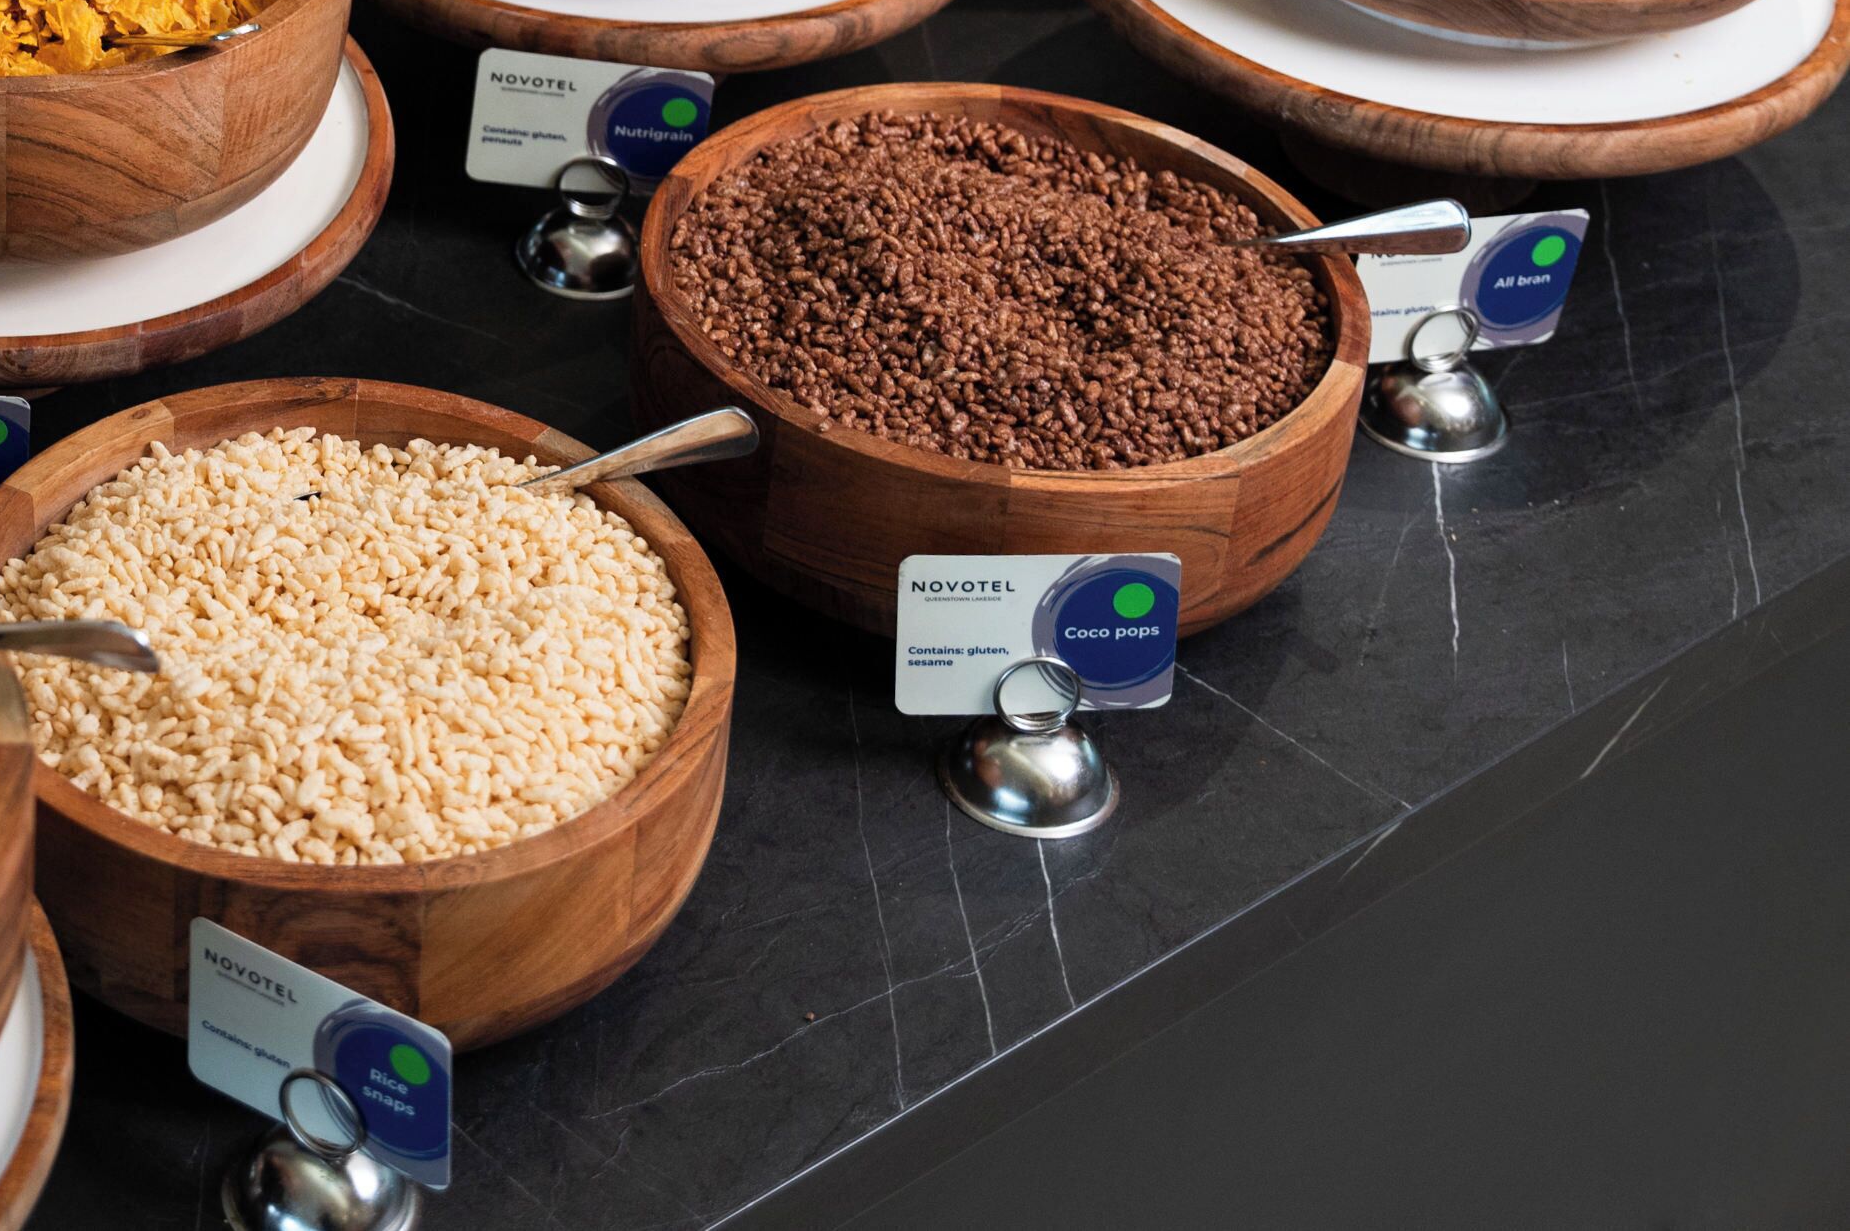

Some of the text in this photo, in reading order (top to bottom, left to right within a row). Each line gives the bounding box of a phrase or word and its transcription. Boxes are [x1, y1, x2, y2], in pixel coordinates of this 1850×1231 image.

[491, 72, 577, 92] NOVOTEL
[614, 125, 693, 143] Nutrigrain
[1494, 273, 1551, 289] All bran
[911, 580, 1015, 592] NOVOTEL
[1064, 626, 1160, 640] Coco pops
[908, 645, 1009, 656] Contains: gluten,
[908, 659, 953, 667] sesame
[204, 948, 297, 1003] NOVOTEL
[254, 1047, 290, 1068] gluten
[370, 1068, 408, 1095] Rice
[362, 1085, 416, 1116] snaps
